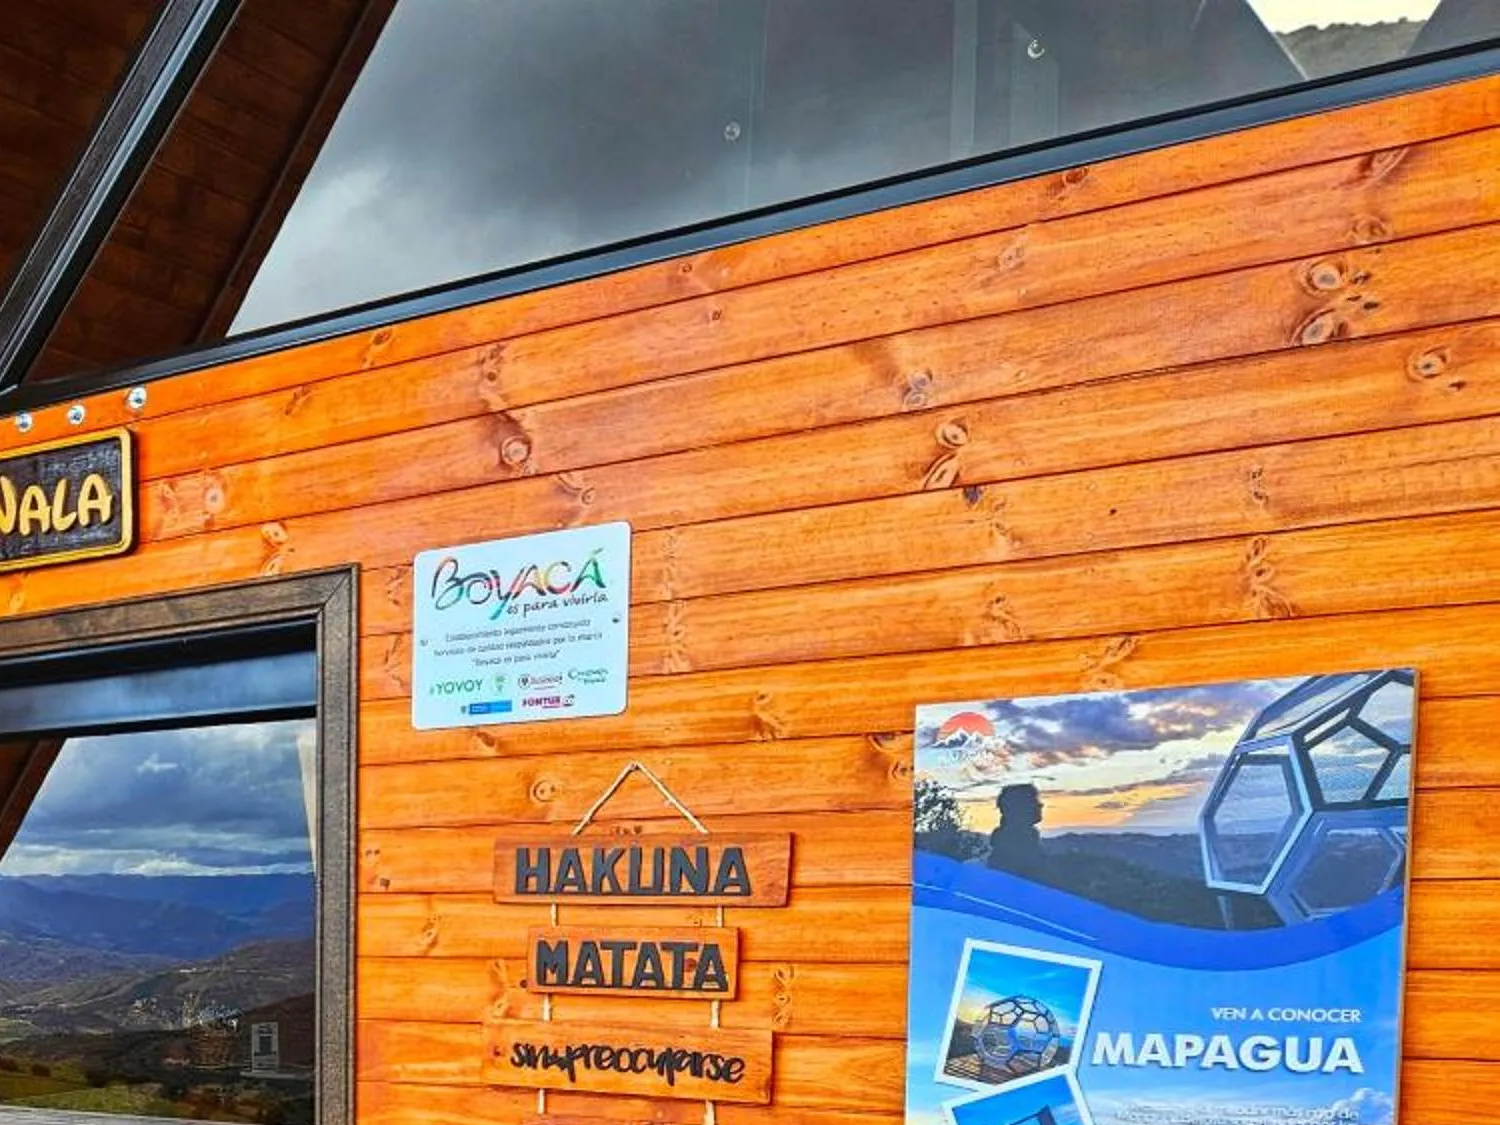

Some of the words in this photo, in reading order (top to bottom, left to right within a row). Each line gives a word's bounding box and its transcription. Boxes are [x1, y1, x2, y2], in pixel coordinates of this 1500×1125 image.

[524, 599, 559, 618] para
[515, 846, 752, 897] HAKUNA
[535, 938, 729, 992] MATATA
[1211, 1007, 1247, 1021] VEN
[1250, 1007, 1264, 1021] A
[1268, 1008, 1362, 1023] CONOCER
[1091, 1031, 1365, 1075] MAPAGUA
